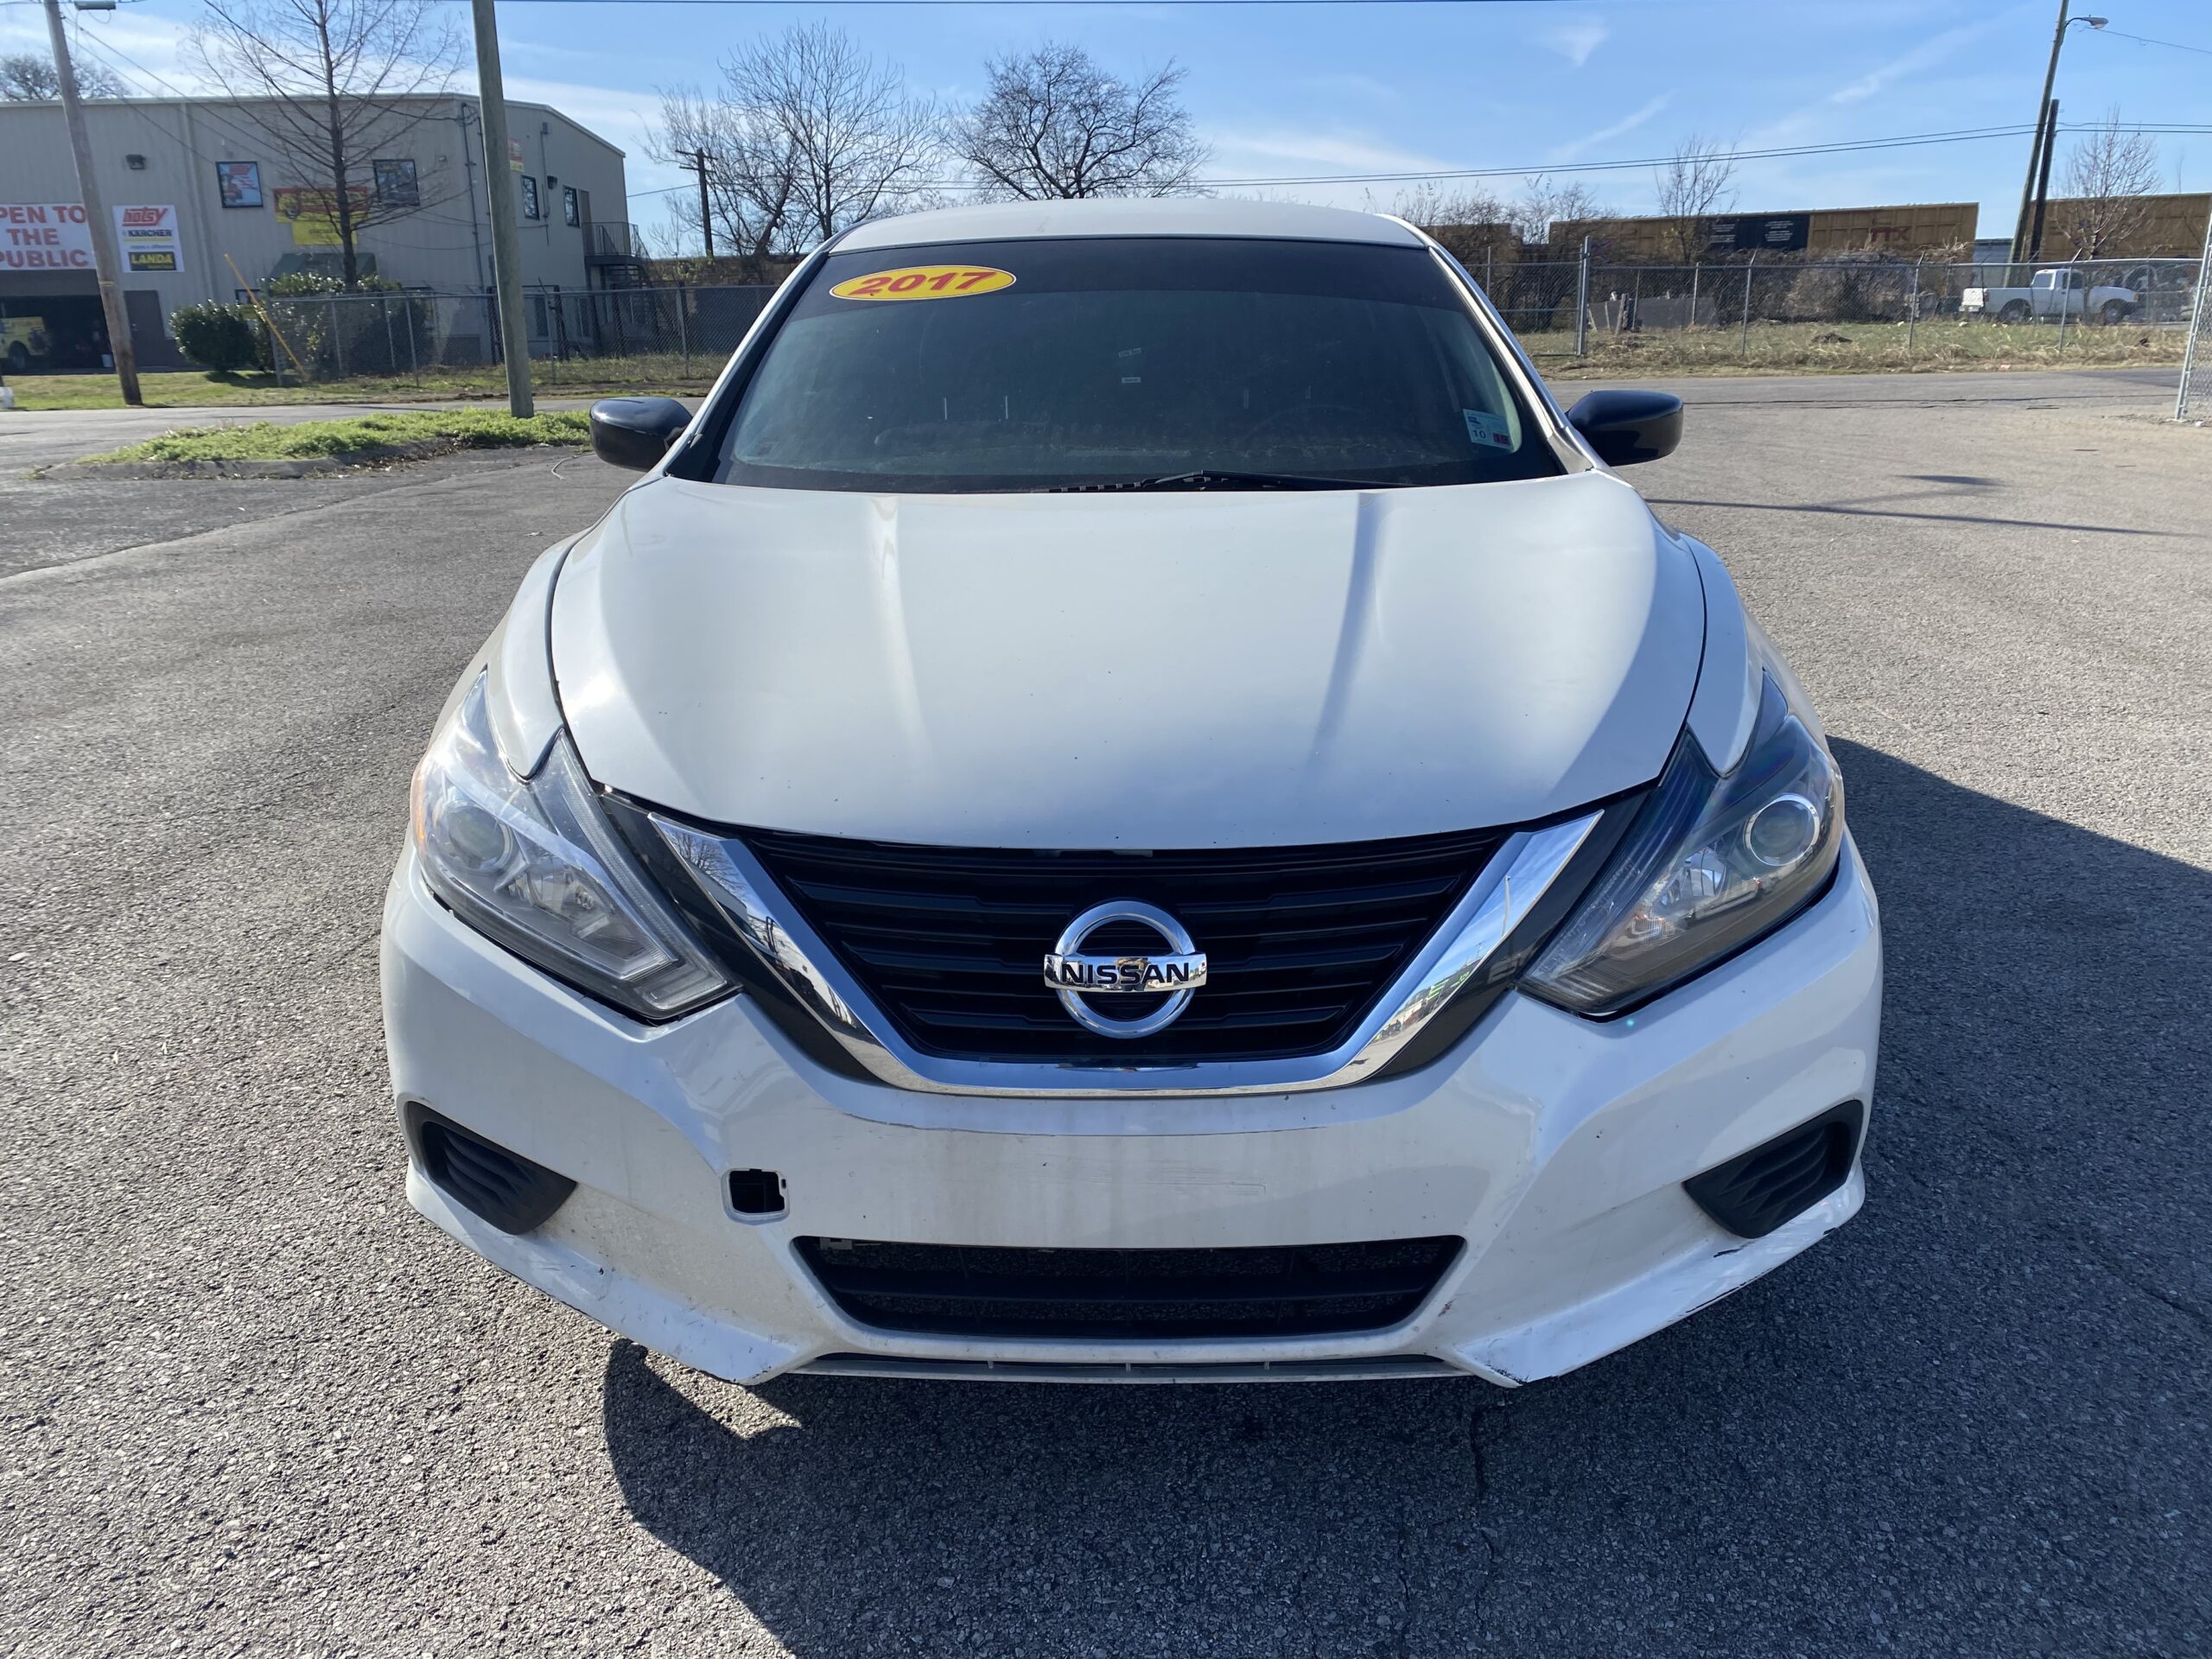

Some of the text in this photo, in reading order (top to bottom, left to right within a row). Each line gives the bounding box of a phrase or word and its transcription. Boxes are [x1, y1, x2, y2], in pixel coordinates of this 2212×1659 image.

[51, 205, 86, 224] TO
[6, 228, 60, 245] THE
[130, 253, 173, 264] LANDA
[848, 271, 997, 296] 2017
[1472, 429, 1486, 439] 10
[1061, 962, 1190, 984] NISSAN
